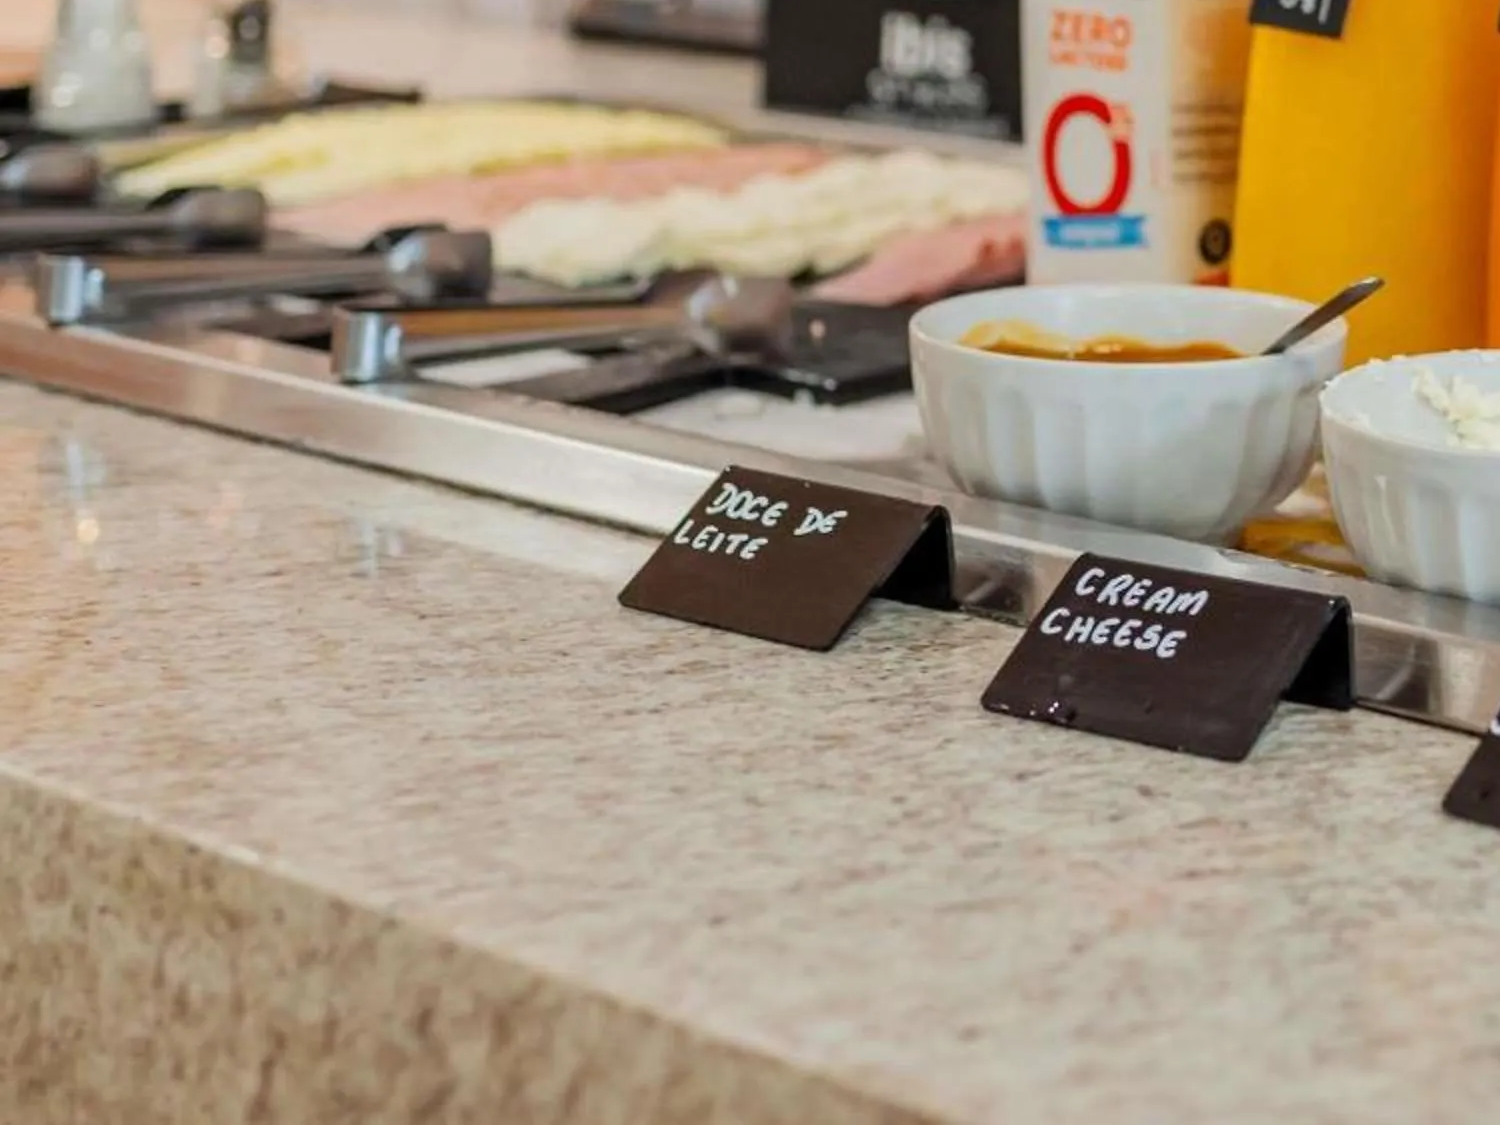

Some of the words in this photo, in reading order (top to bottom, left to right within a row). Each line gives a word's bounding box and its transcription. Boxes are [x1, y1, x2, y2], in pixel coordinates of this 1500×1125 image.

[1051, 9, 1133, 47] ZERO
[705, 482, 789, 527] DOCE
[793, 506, 848, 536] DE
[673, 519, 768, 560] LEITE
[1074, 567, 1209, 617] CREAM
[1040, 607, 1187, 659] CHEESE
